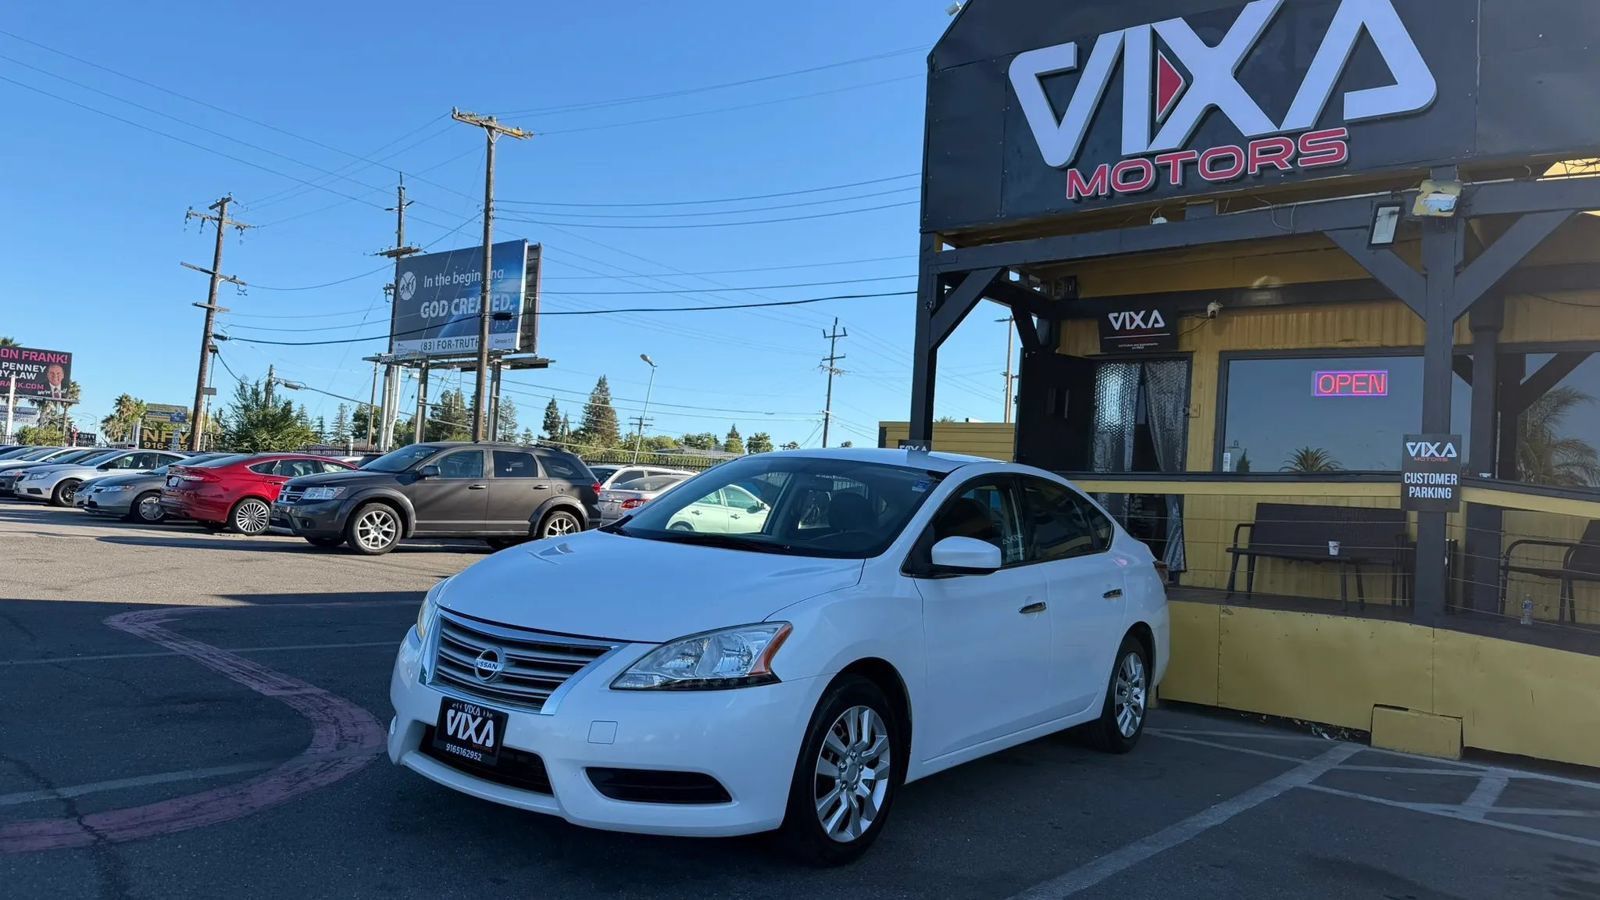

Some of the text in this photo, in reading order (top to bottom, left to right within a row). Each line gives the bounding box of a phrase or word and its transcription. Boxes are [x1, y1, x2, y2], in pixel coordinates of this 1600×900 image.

[1008, 0, 1437, 168] VIXA
[1065, 127, 1350, 200] MOTORS
[424, 275, 433, 288] In
[435, 273, 451, 287] the
[453, 268, 504, 286] beginng
[420, 294, 515, 319] GOD CREAED.
[1108, 309, 1166, 331] VIXA
[421, 341, 435, 352] (83)
[2, 362, 47, 373] PENNEY
[22, 351, 68, 364] FRANK!
[1319, 374, 1385, 394] OPEN
[1406, 441, 1457, 457] VIXA
[1404, 472, 1458, 485] CUSTOMER
[1409, 487, 1452, 499] PARKING
[447, 709, 494, 748] VIXA
